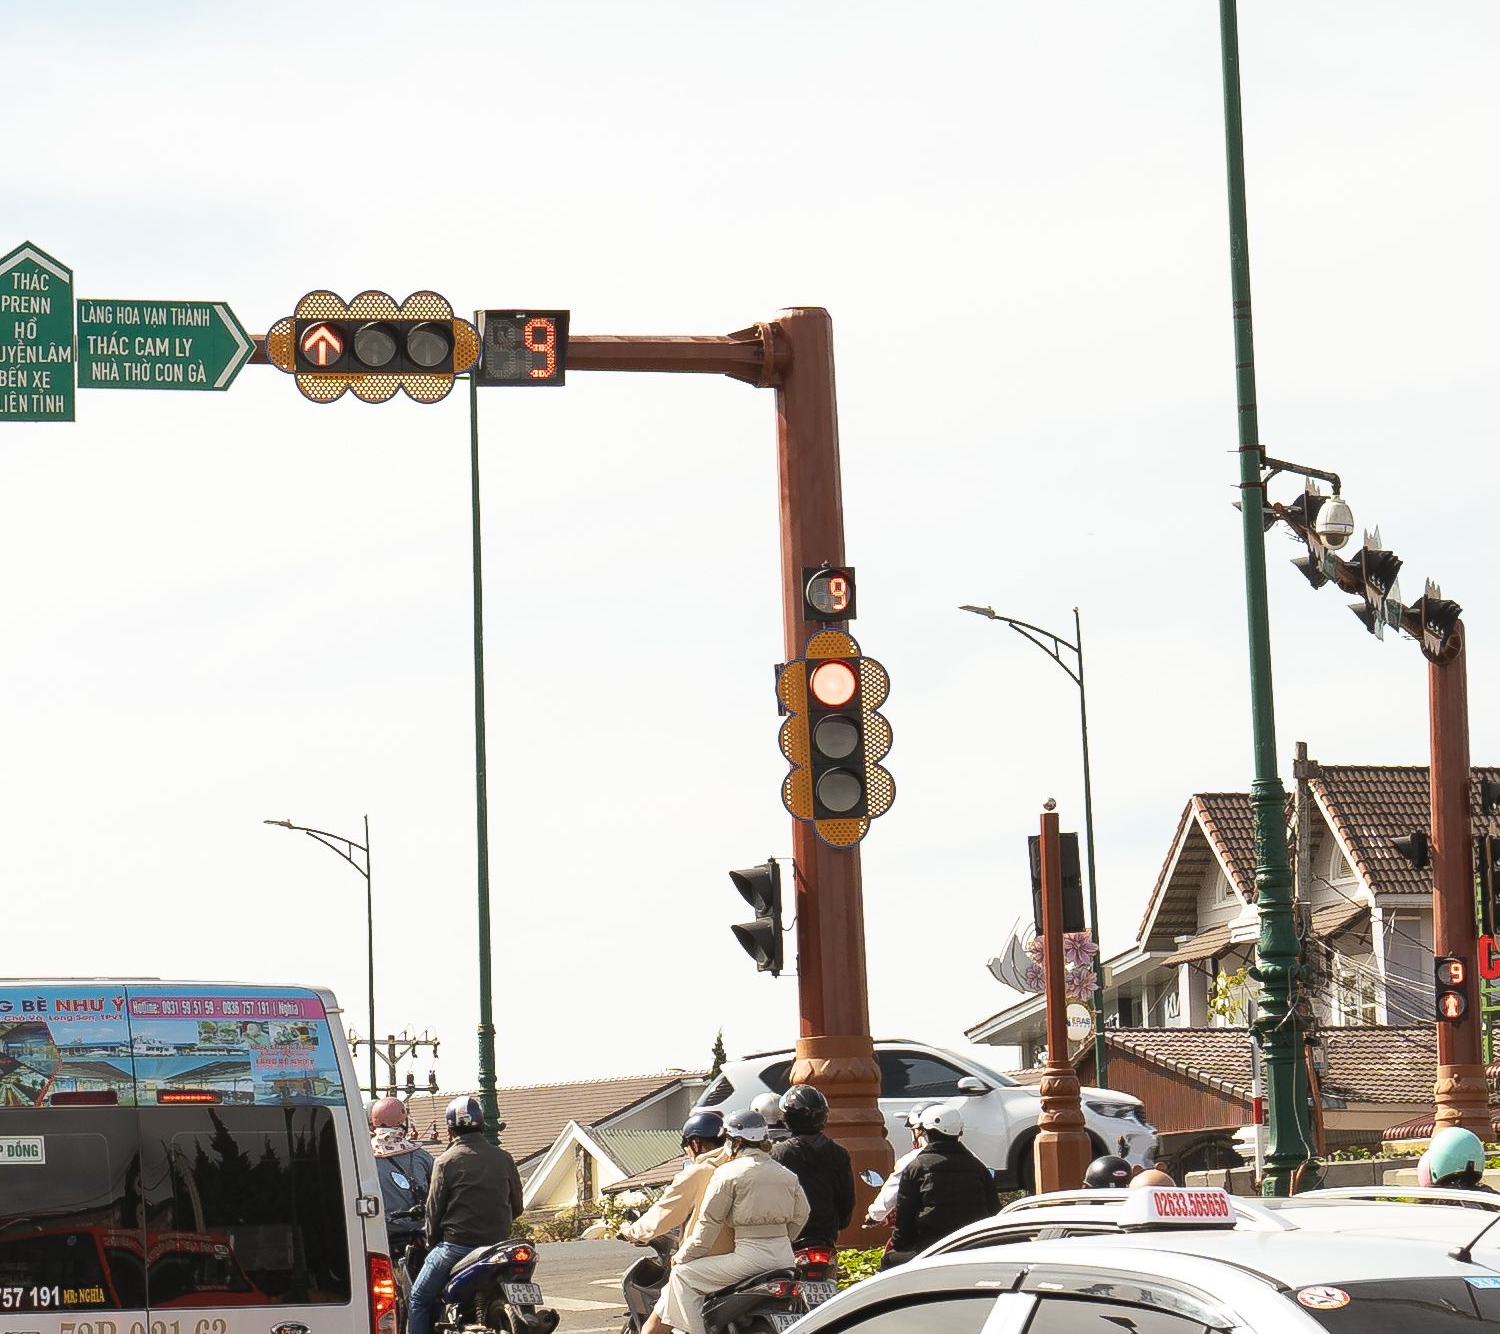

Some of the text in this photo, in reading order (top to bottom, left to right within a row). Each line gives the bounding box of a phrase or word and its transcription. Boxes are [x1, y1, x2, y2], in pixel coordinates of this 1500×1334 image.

[11, 269, 50, 291] THÁC
[1, 295, 51, 314] PRENN
[81, 301, 210, 329] LÀNG HOA VẠN THÀNH
[14, 316, 38, 339] HỒ
[86, 330, 193, 357] THÁC CAM LY
[32, 370, 51, 389] XE
[91, 357, 207, 383] NHÀ THỜ CON GÀ
[31, 387, 64, 413] TỈNH
[21, 996, 48, 1013] BÈ
[55, 996, 105, 1012] NHƯ
[111, 995, 125, 1012] Ý
[30, 1286, 60, 1307] 191
